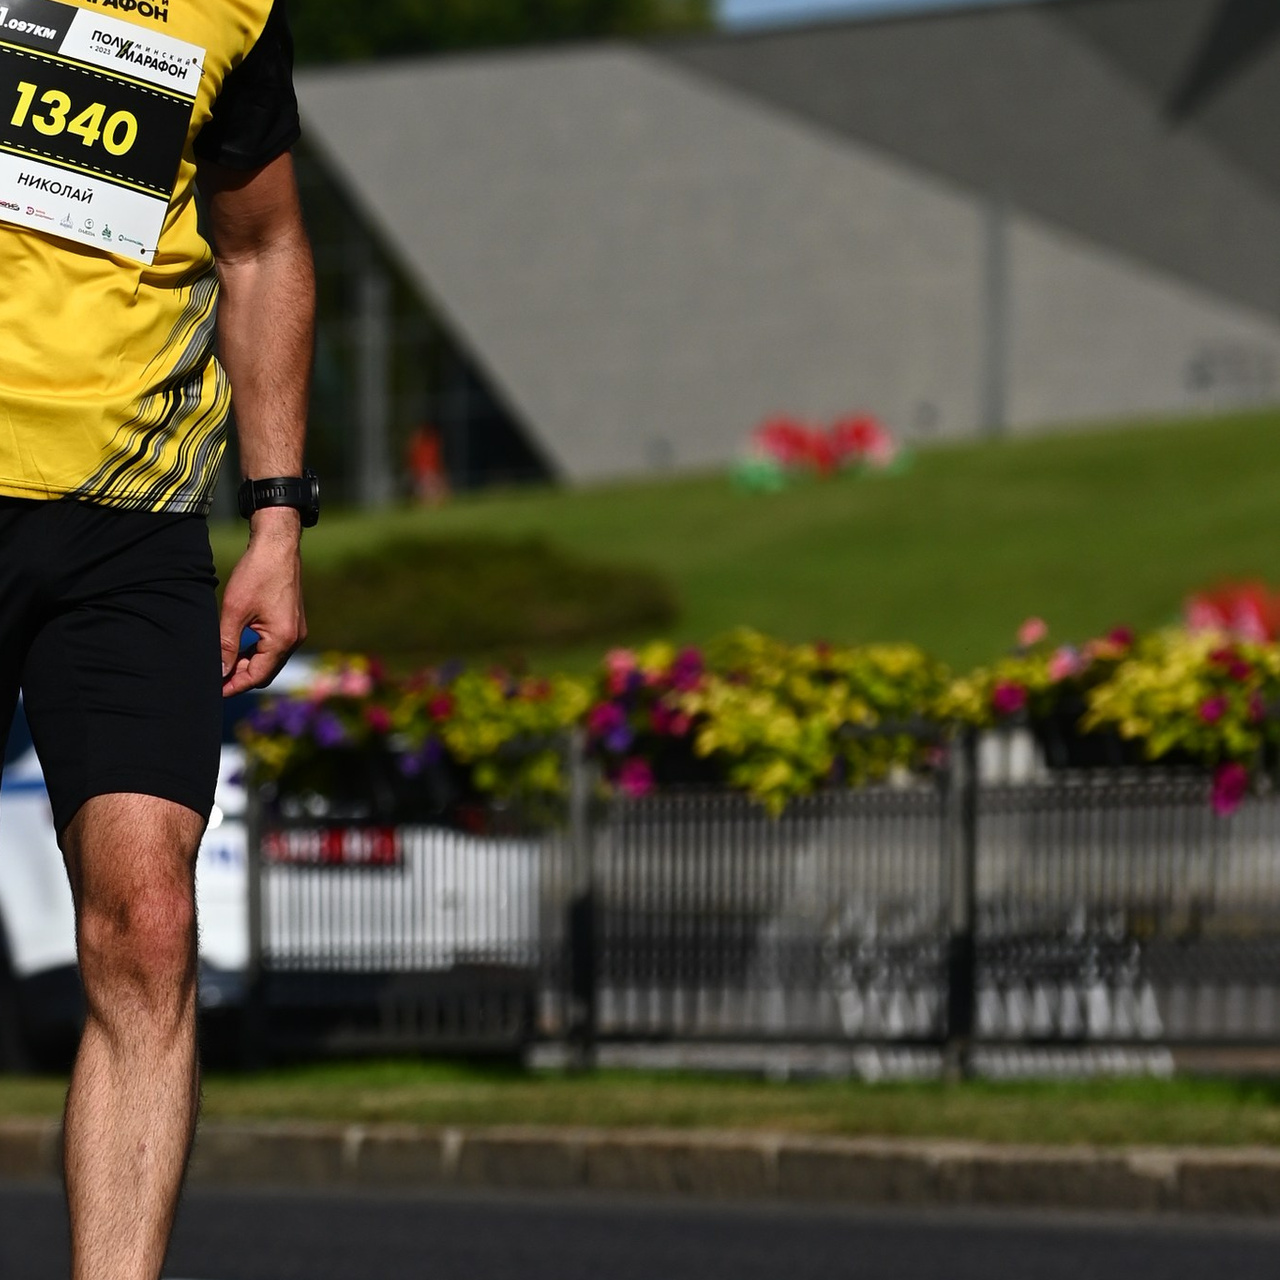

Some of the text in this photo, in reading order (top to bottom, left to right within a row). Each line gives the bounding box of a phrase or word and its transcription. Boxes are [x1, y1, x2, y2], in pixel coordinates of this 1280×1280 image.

[95, 45, 111, 55] 2023
[119, 50, 187, 80] МАРАФОН
[134, 43, 191, 65] МИНСКИЙ
[10, 81, 138, 156] 1340
[17, 173, 94, 205] НИКОЛАЙ
